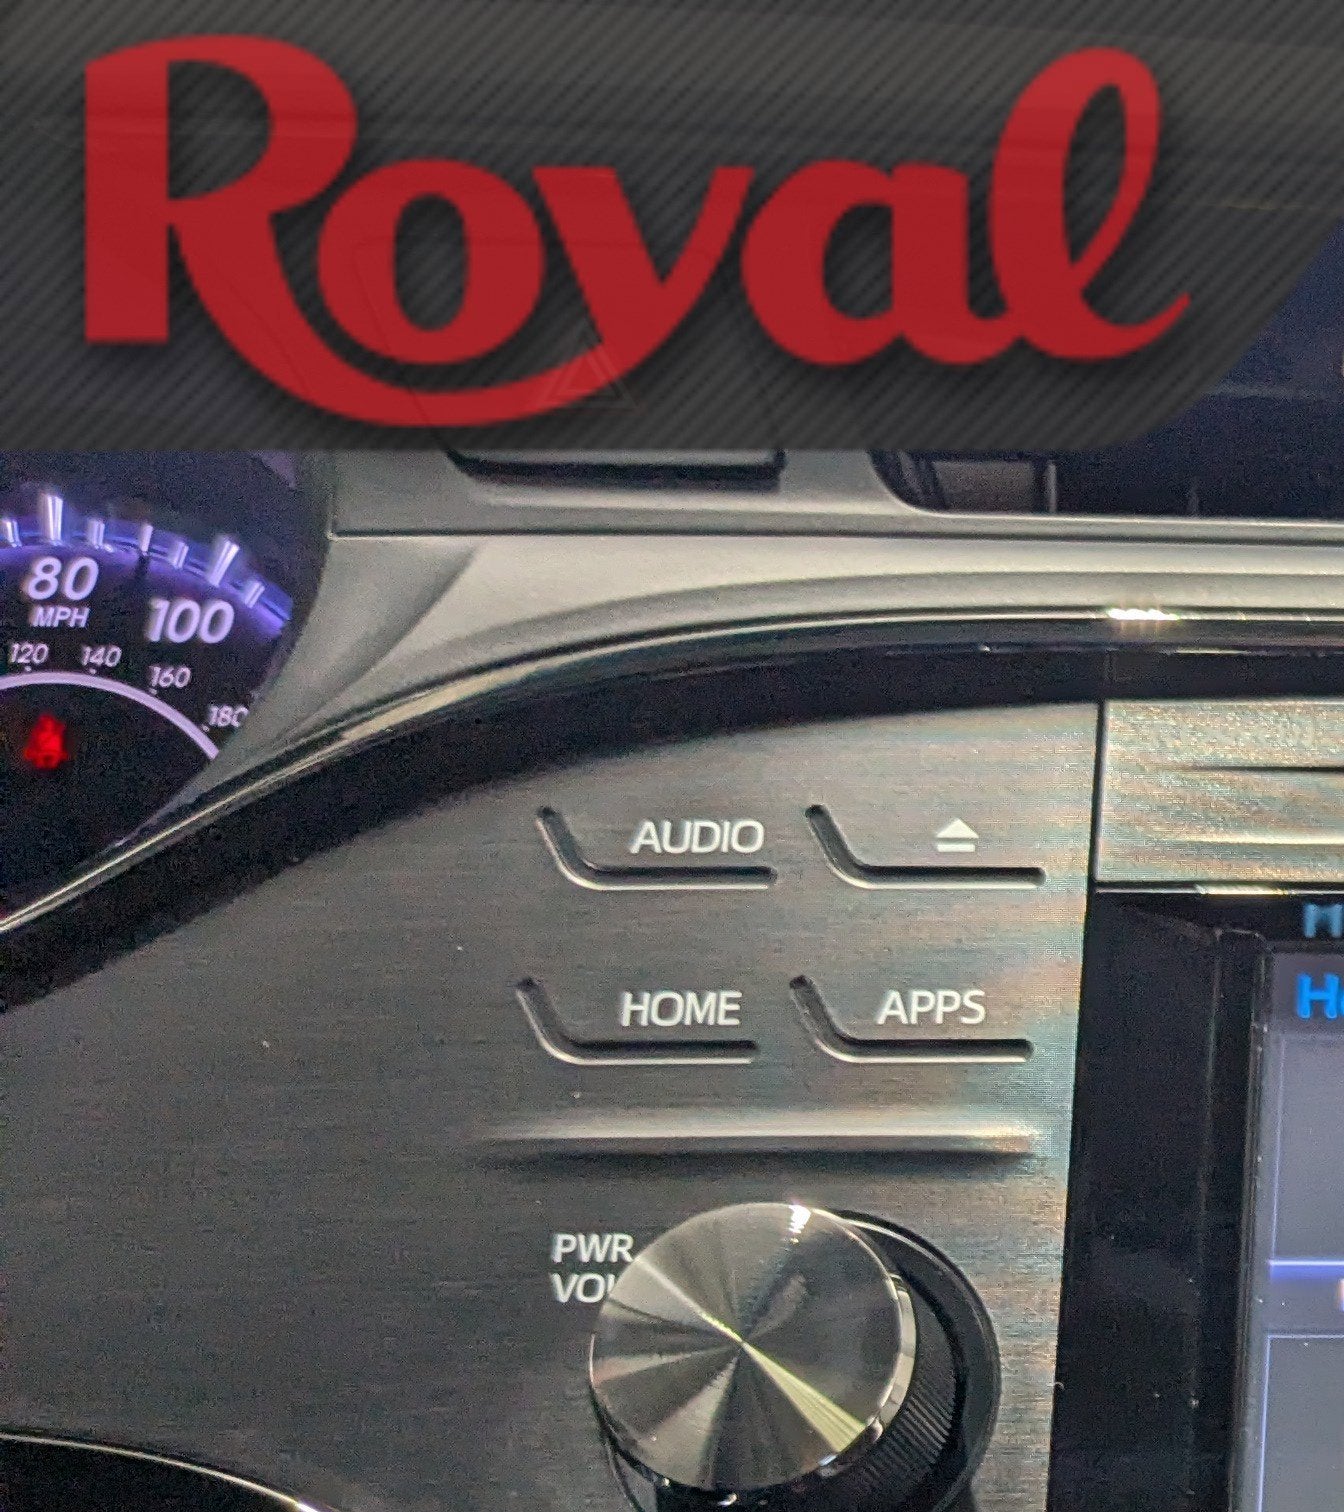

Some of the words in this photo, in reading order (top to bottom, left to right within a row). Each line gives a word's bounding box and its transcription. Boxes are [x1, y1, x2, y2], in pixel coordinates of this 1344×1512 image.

[27, 556, 99, 600] 80
[30, 606, 90, 628] MPH
[147, 599, 236, 644] 100
[10, 643, 49, 664] 120
[82, 646, 122, 667] 140
[150, 666, 191, 688] 160
[630, 819, 765, 855] AUDIO
[621, 990, 743, 1027] HOME
[877, 989, 987, 1026] APPS
[551, 1232, 635, 1262] PWR
